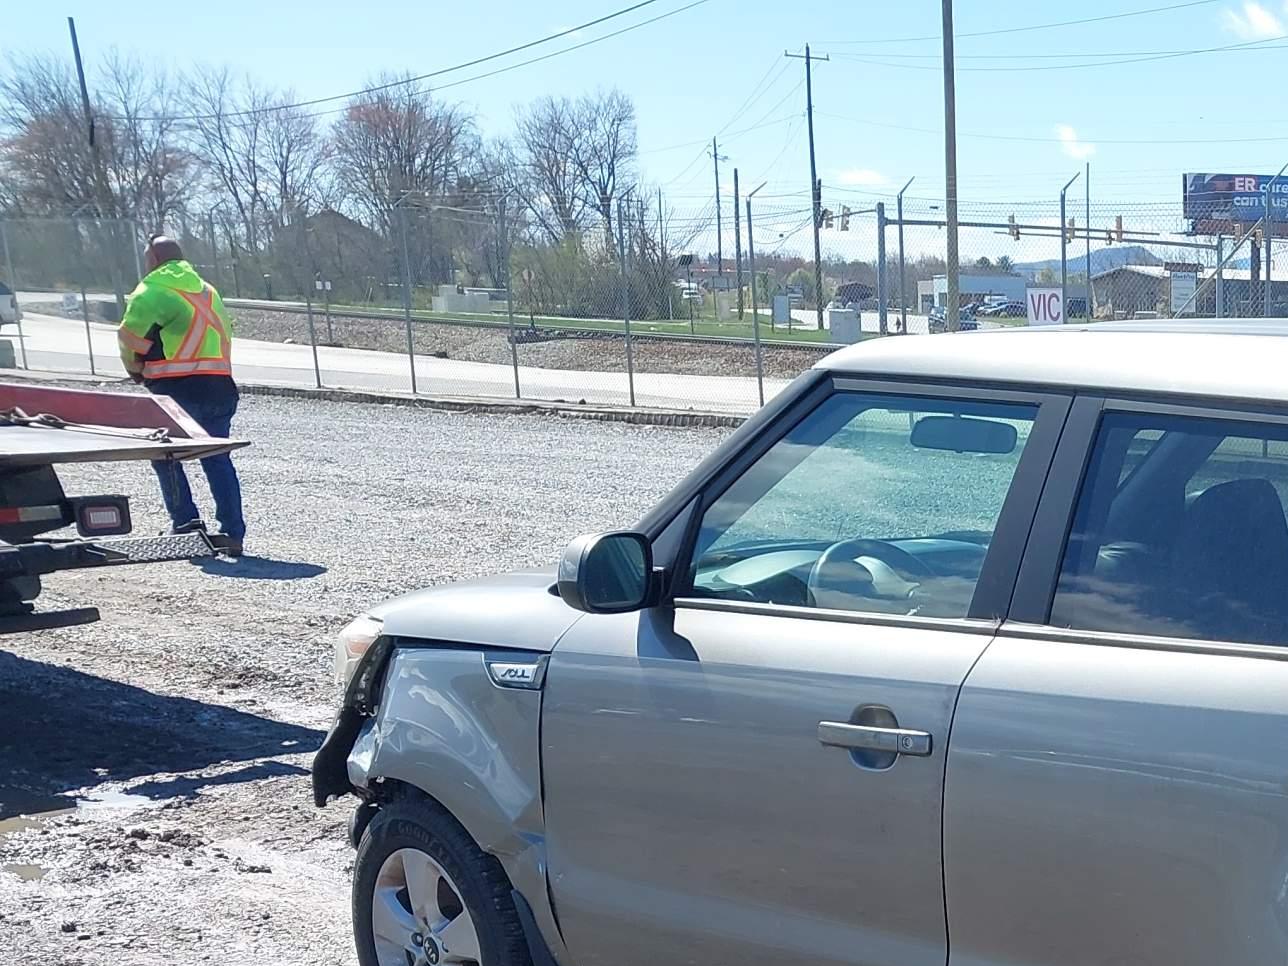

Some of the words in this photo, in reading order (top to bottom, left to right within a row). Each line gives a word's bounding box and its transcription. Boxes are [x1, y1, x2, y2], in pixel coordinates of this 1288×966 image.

[1234, 177, 1256, 192] ER
[1233, 196, 1259, 206] can
[1030, 293, 1061, 322] VIC
